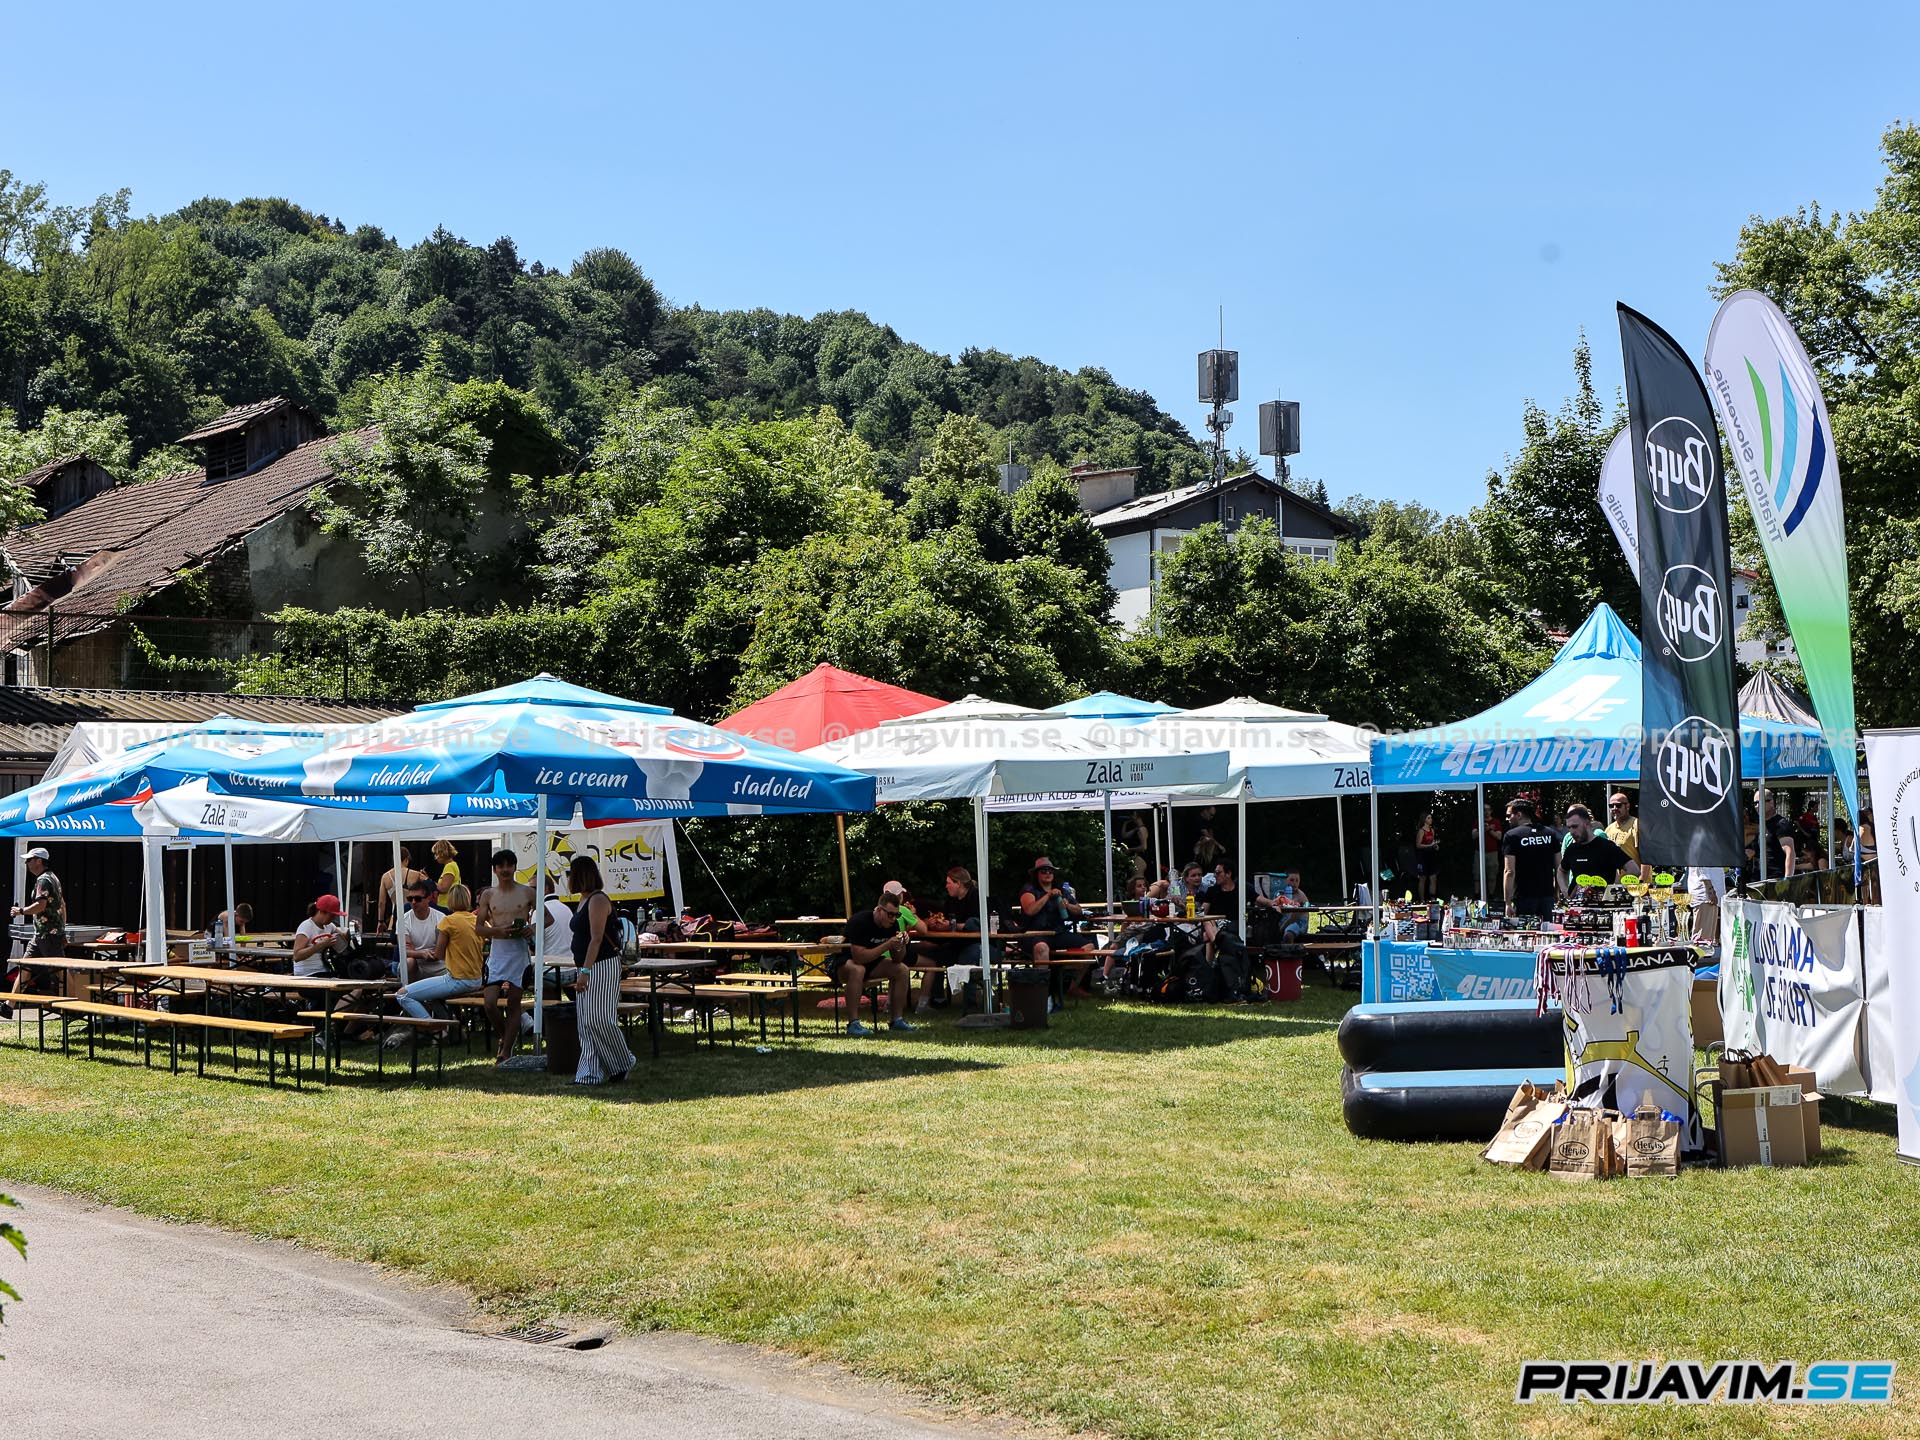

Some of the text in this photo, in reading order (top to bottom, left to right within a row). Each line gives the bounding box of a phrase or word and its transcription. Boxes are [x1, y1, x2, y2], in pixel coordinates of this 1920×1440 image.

[1441, 739, 1641, 777] 4ENDURANC
[229, 771, 245, 786] ice
[367, 763, 441, 787] sladoled
[535, 767, 629, 788] ice cream
[1085, 761, 1123, 785] Zala
[1334, 768, 1370, 788] Zala
[732, 774, 814, 800] sladoled
[1048, 791, 1078, 801] KLUB
[200, 804, 226, 826] Zala
[1520, 835, 1552, 847] CREW
[1890, 806, 1909, 877] Slovenska
[1752, 922, 1815, 973] LJUBLJANA
[1766, 976, 1776, 1020] JE
[1562, 1144, 1588, 1157] Hervis
[1636, 1139, 1663, 1152] Hervis
